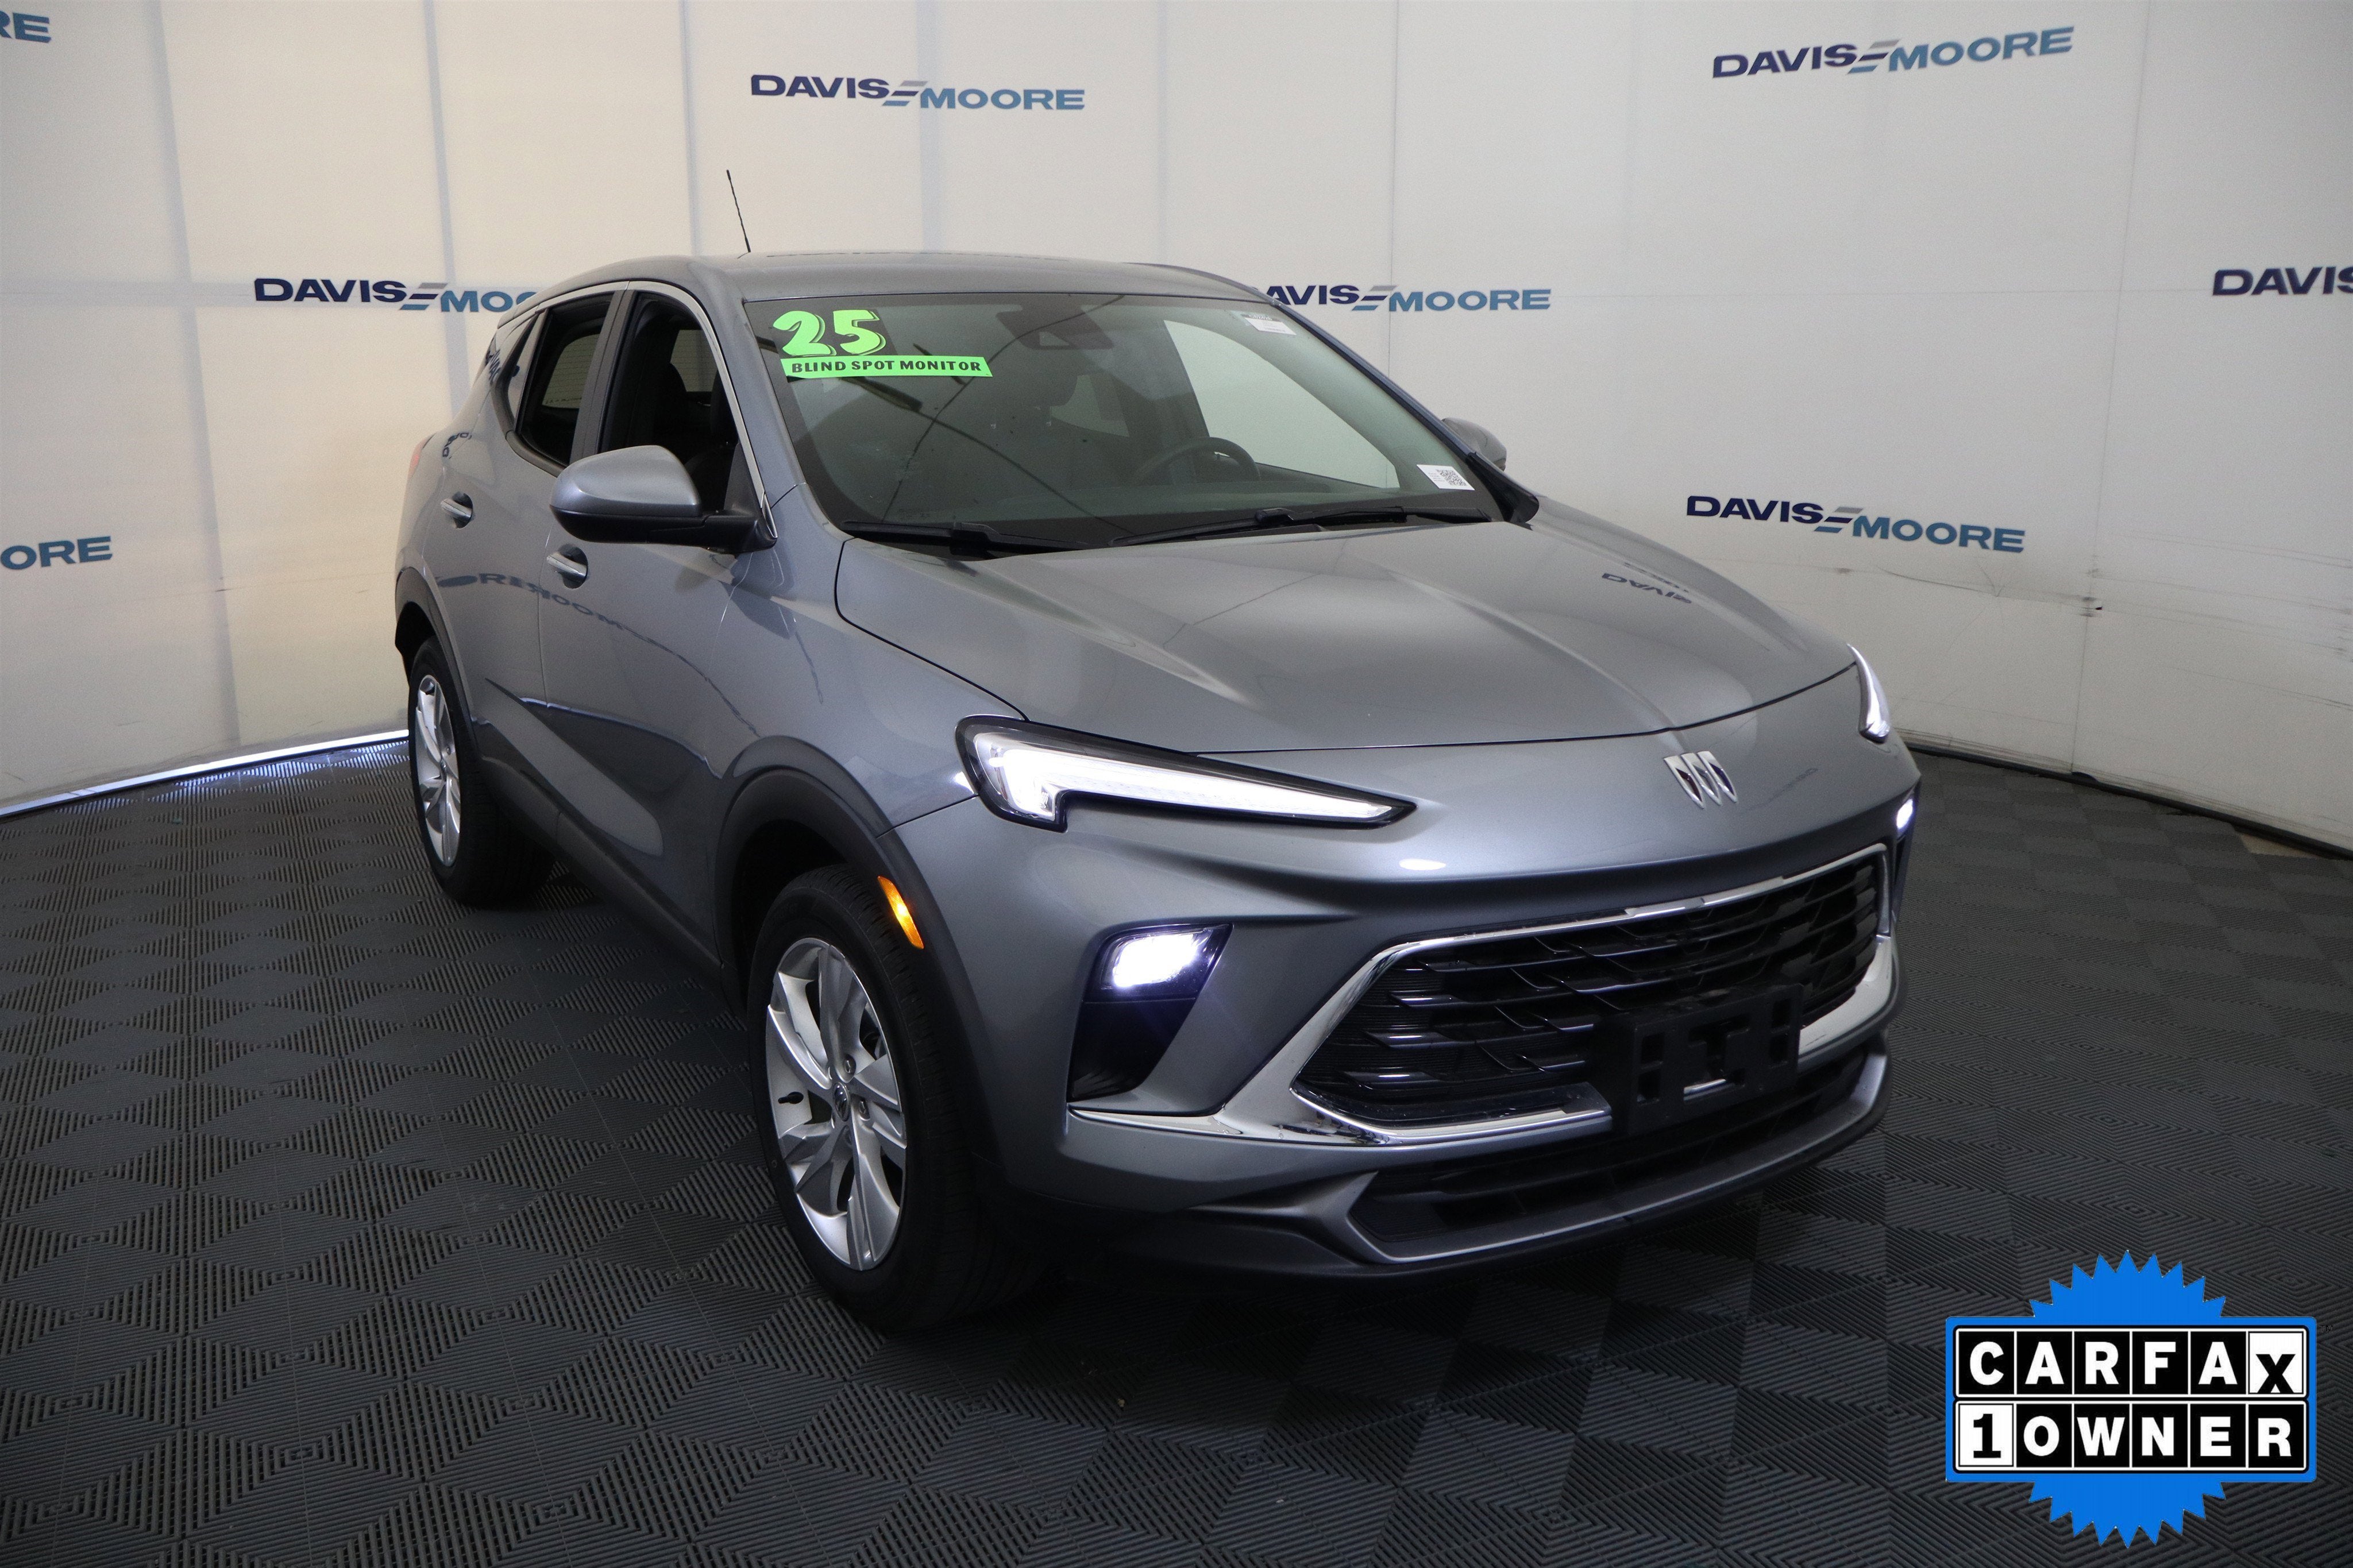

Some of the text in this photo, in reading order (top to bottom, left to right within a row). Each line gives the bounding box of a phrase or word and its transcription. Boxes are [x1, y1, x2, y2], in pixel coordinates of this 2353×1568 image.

[1712, 26, 2074, 78] DAVIS MOORE
[751, 75, 1085, 109] DAVIS MOORE
[254, 279, 408, 303] DAVIS
[1266, 285, 1551, 311] AVIS MOORE
[773, 309, 886, 356] 25
[792, 361, 981, 373] BLIND SPOT MONITOR
[1687, 495, 2025, 553] DAVIS MOORE
[0, 536, 113, 570] ORE
